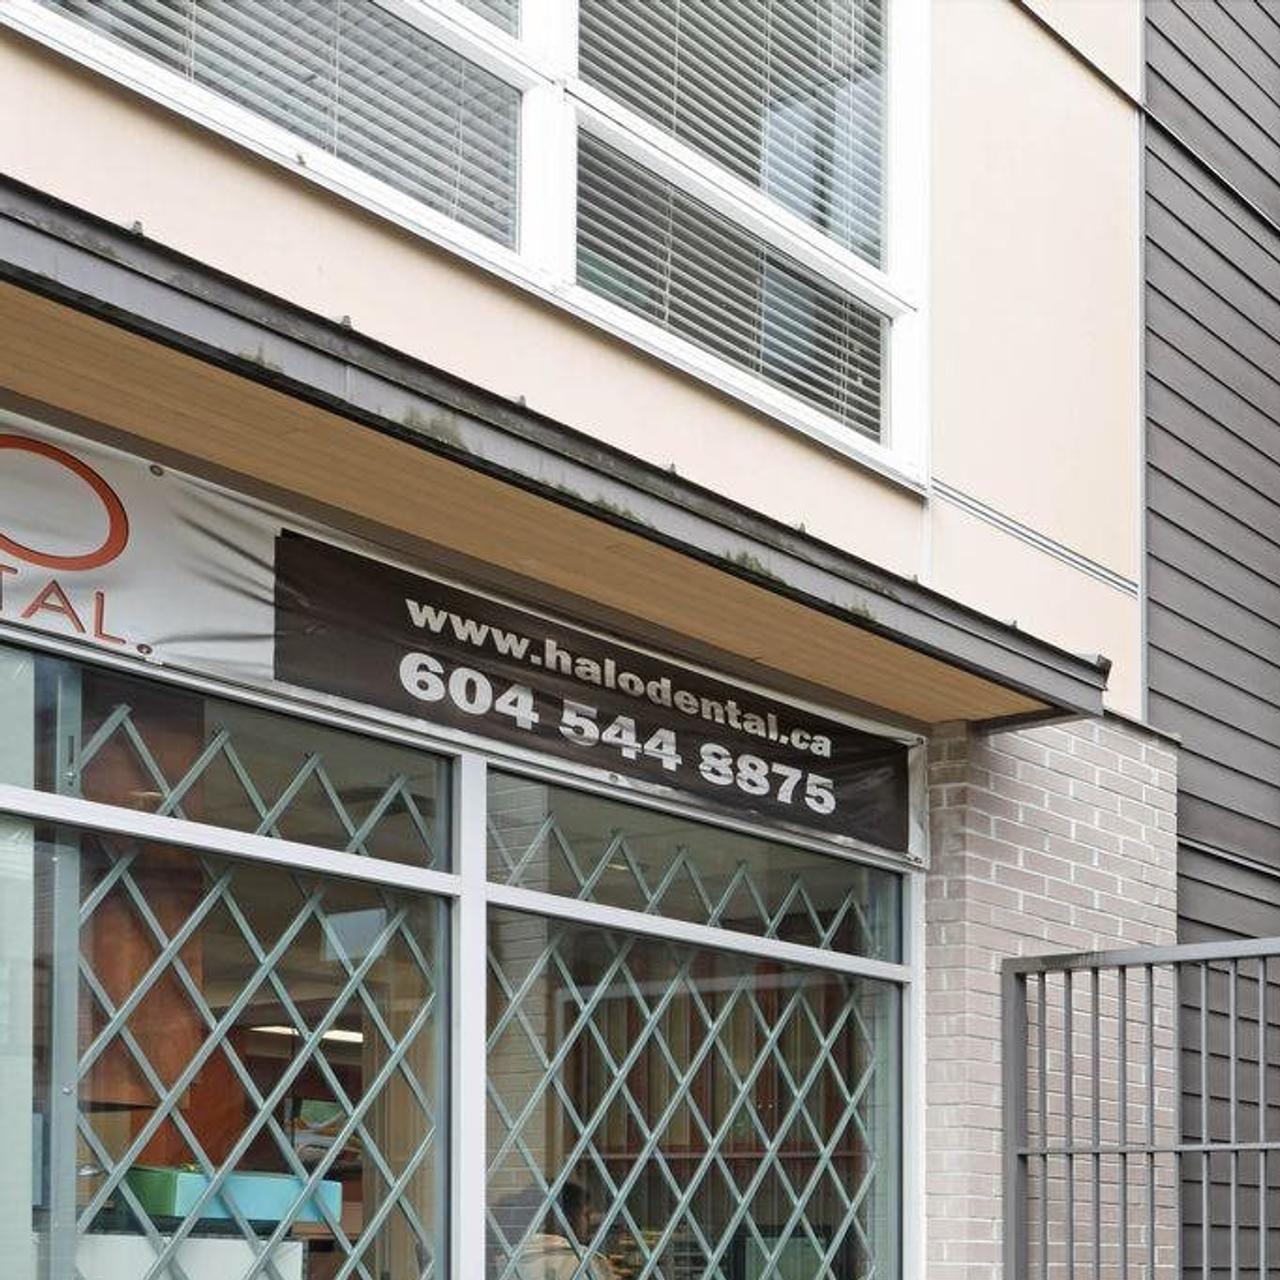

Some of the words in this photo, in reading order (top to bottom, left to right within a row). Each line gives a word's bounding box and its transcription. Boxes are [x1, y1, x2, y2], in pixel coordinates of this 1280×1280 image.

[399, 652, 540, 730] 604
[558, 699, 683, 772] 544
[698, 743, 837, 816] 8875
[404, 598, 832, 758] www.halodental.ca
